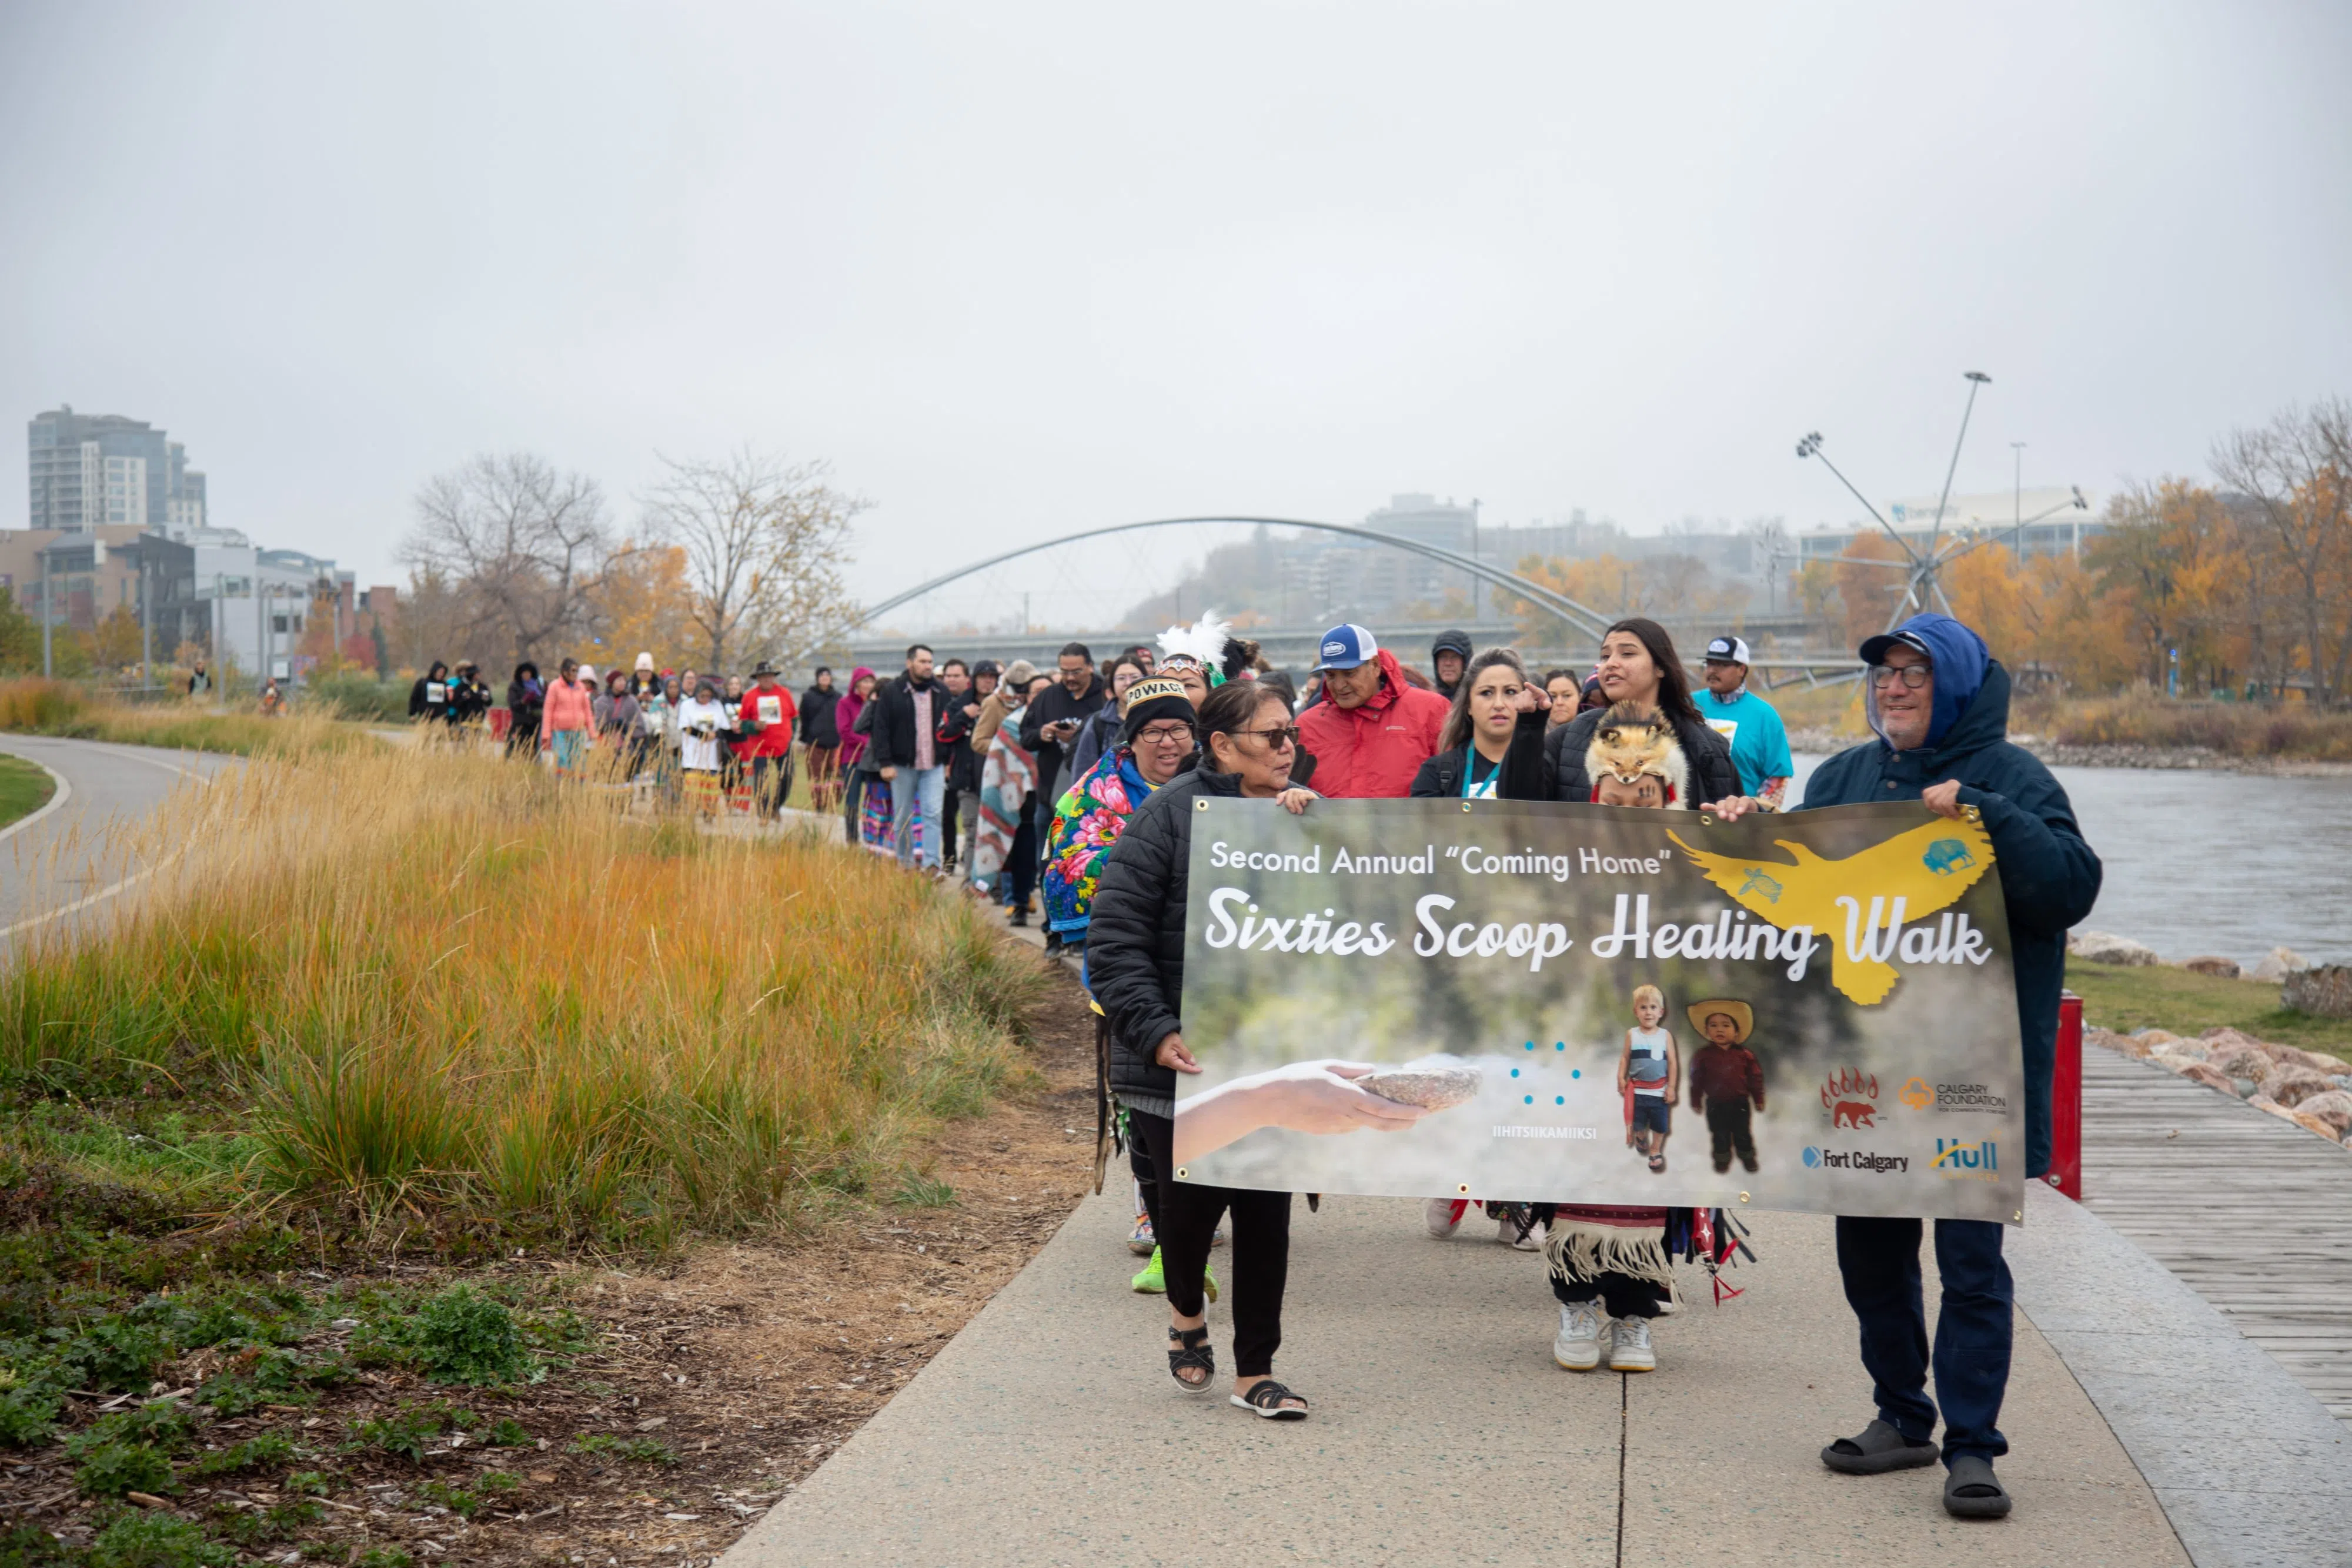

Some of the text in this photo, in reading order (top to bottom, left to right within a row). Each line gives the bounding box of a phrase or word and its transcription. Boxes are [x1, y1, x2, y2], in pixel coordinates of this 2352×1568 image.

[1210, 841, 1320, 874] Second
[1331, 844, 1434, 874] Annual
[1445, 846, 1569, 882] “Coming
[1205, 887, 1993, 982] Sixties Scoop Healing Walk
[1937, 1084, 1989, 1094] CALGARY
[1937, 1094, 2006, 1107] FOUNDATION
[1492, 1125, 1598, 1139] IIHITSIIKAMIIKSI
[1823, 1149, 1909, 1174] Fort Calgary
[1936, 1138, 1997, 1170] Hull
